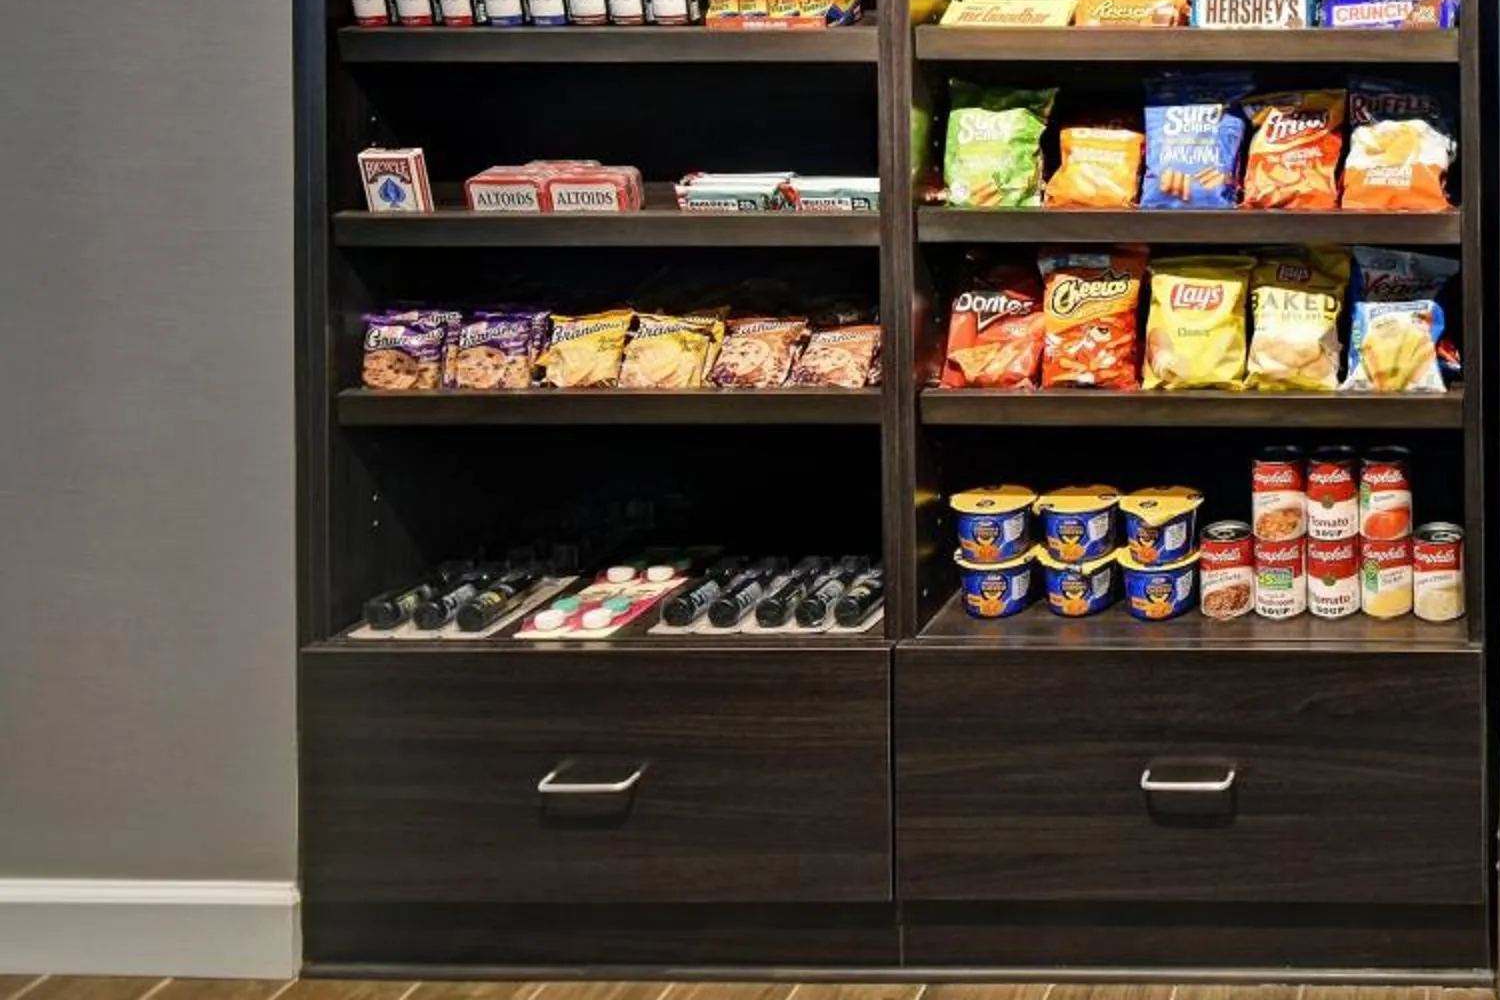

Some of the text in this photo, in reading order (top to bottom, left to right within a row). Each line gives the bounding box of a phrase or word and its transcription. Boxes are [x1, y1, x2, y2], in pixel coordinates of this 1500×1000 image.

[1334, 3, 1409, 22] CRUNCH
[364, 158, 410, 176] BICYCLE
[477, 191, 534, 206] ALTOIDS
[556, 190, 614, 206] ALTOIDS
[954, 291, 1034, 317] Doritos
[1251, 290, 1338, 313] BAKED
[1311, 516, 1349, 529] Tomato
